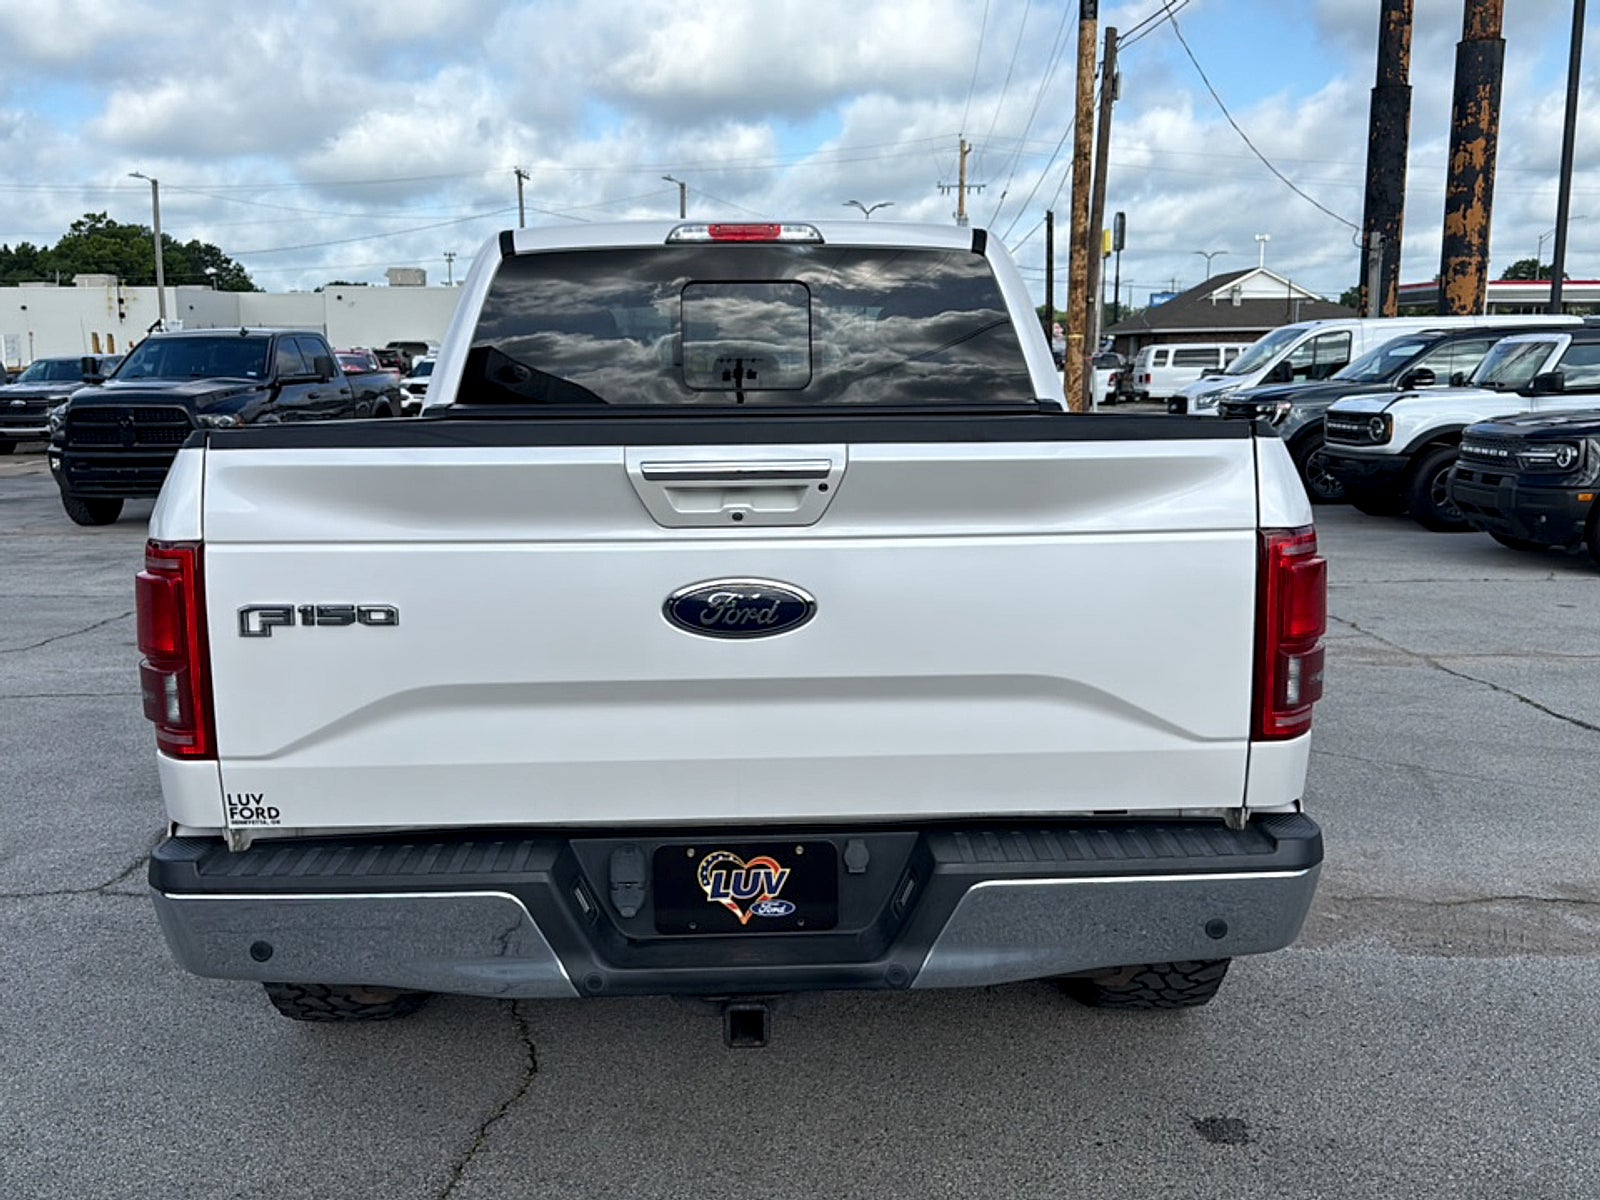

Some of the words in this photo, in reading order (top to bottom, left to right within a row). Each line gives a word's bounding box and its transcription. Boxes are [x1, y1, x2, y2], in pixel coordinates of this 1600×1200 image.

[237, 604, 400, 638] F150
[700, 591, 780, 626] Ford
[227, 793, 263, 806] LUV
[229, 807, 280, 819] FORD
[707, 868, 790, 901] LUV
